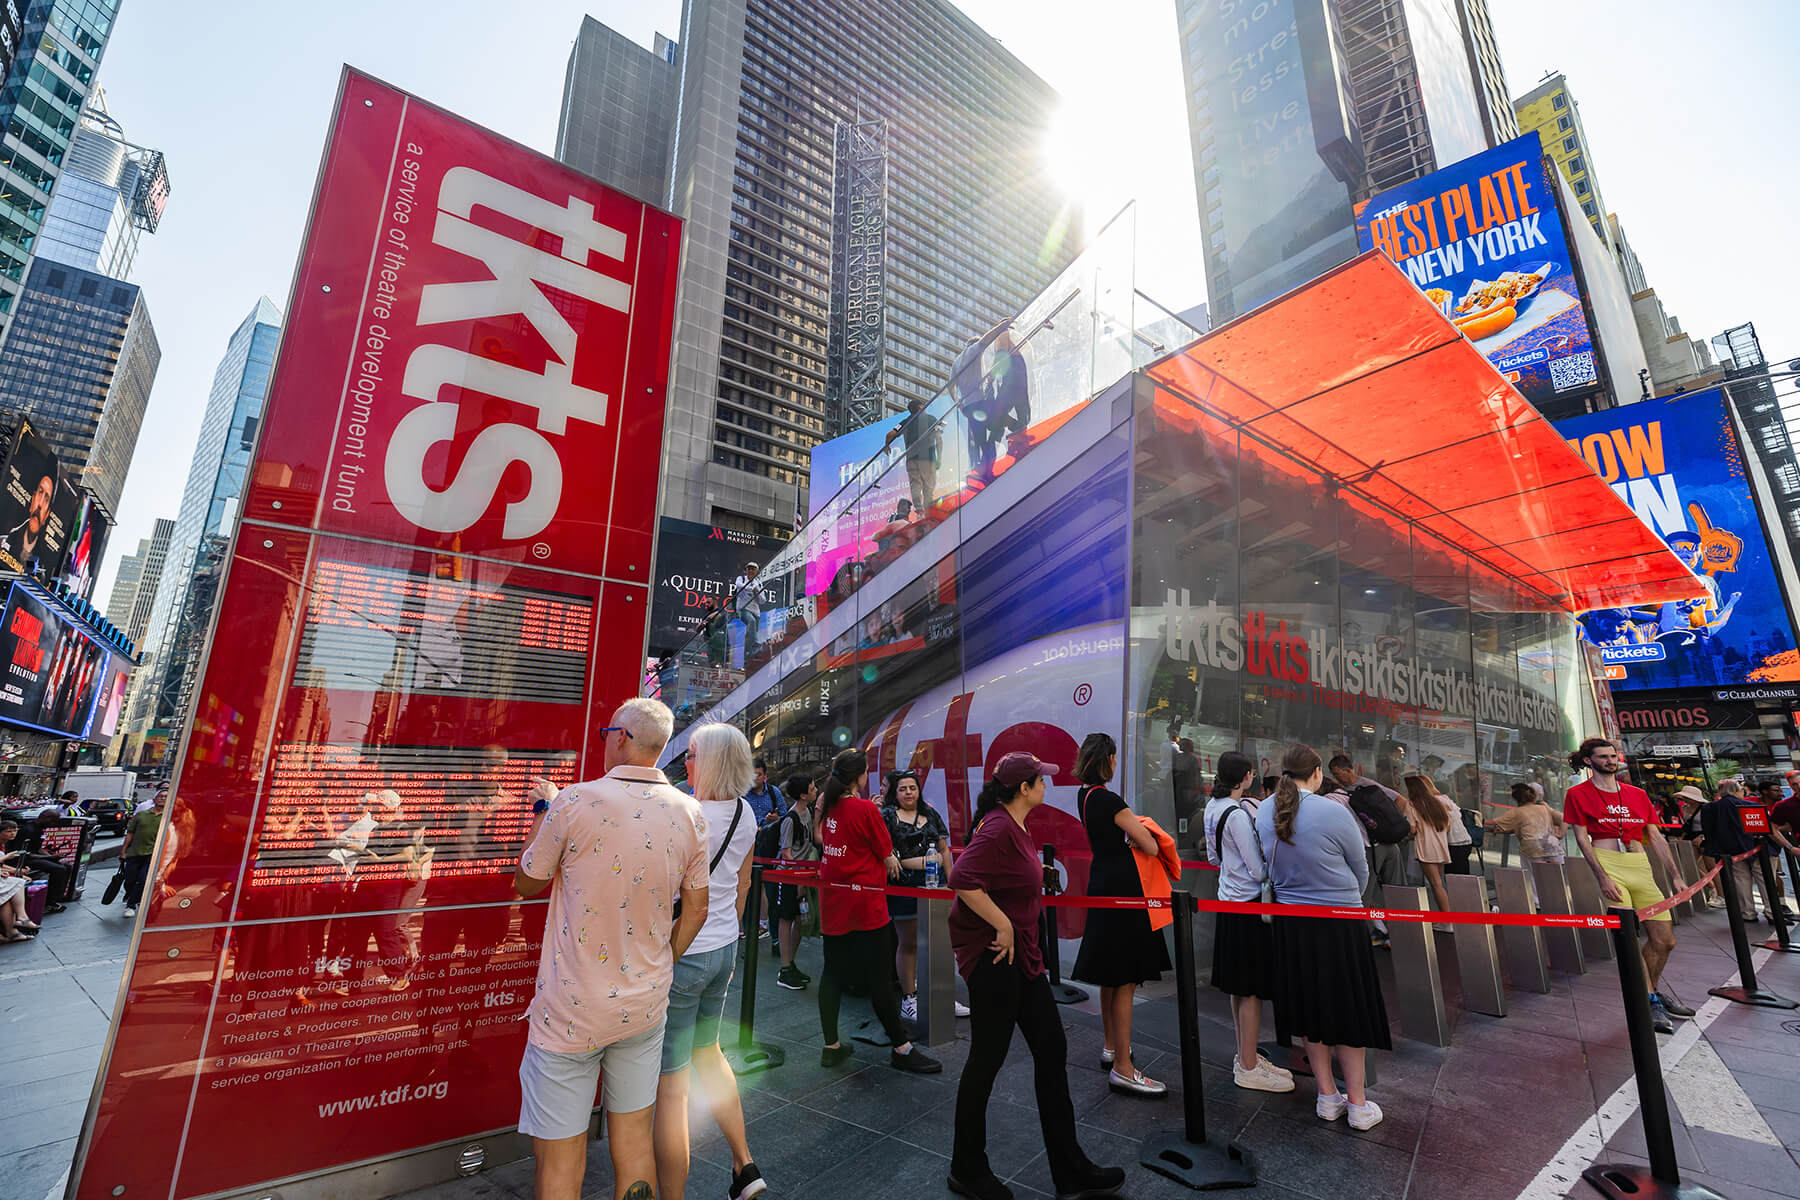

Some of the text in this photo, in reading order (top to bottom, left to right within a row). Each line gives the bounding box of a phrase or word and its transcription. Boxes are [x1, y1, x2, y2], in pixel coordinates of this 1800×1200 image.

[1369, 160, 1539, 264] BEST PLATE
[1373, 201, 1409, 221] THE
[1404, 212, 1548, 286] NEW YORK
[331, 143, 424, 514] a service of theatre development fund
[383, 166, 632, 540] tkts
[727, 530, 760, 541] MARRIOTT
[727, 536, 756, 546] MARQUIS
[661, 578, 669, 587] A
[670, 574, 724, 596] QUIET
[1162, 587, 1246, 673] tkts
[1243, 610, 1310, 684] tkts
[262, 841, 316, 849] TITANIQUE
[252, 877, 281, 887] BOOTH
[300, 874, 327, 884] order
[274, 866, 310, 877] tickets
[313, 864, 337, 876] MUST
[1369, 909, 1385, 919] tkts
[1586, 917, 1605, 927] tkts
[235, 967, 294, 982] Welcome
[298, 966, 310, 976] to
[355, 959, 373, 969] the
[377, 955, 408, 967] booth
[411, 953, 426, 963] for
[428, 947, 479, 962] same-day
[481, 942, 522, 956] discount
[225, 979, 501, 1024] Operated with the cooperation of The League of
[230, 992, 242, 1003] to
[404, 970, 435, 983] Music
[438, 969, 446, 977] &
[450, 965, 482, 977] Dance
[223, 991, 526, 1045] Theaters & Producers. The City of New York tkts is
[215, 1018, 473, 1067] a program of Theatre Development Fund. A
[211, 1072, 260, 1089] service
[263, 1058, 342, 1081] organization
[344, 1055, 362, 1067] for
[364, 1051, 382, 1064] the
[385, 1040, 445, 1063] performing
[318, 1080, 449, 1118] www.tdf.org
